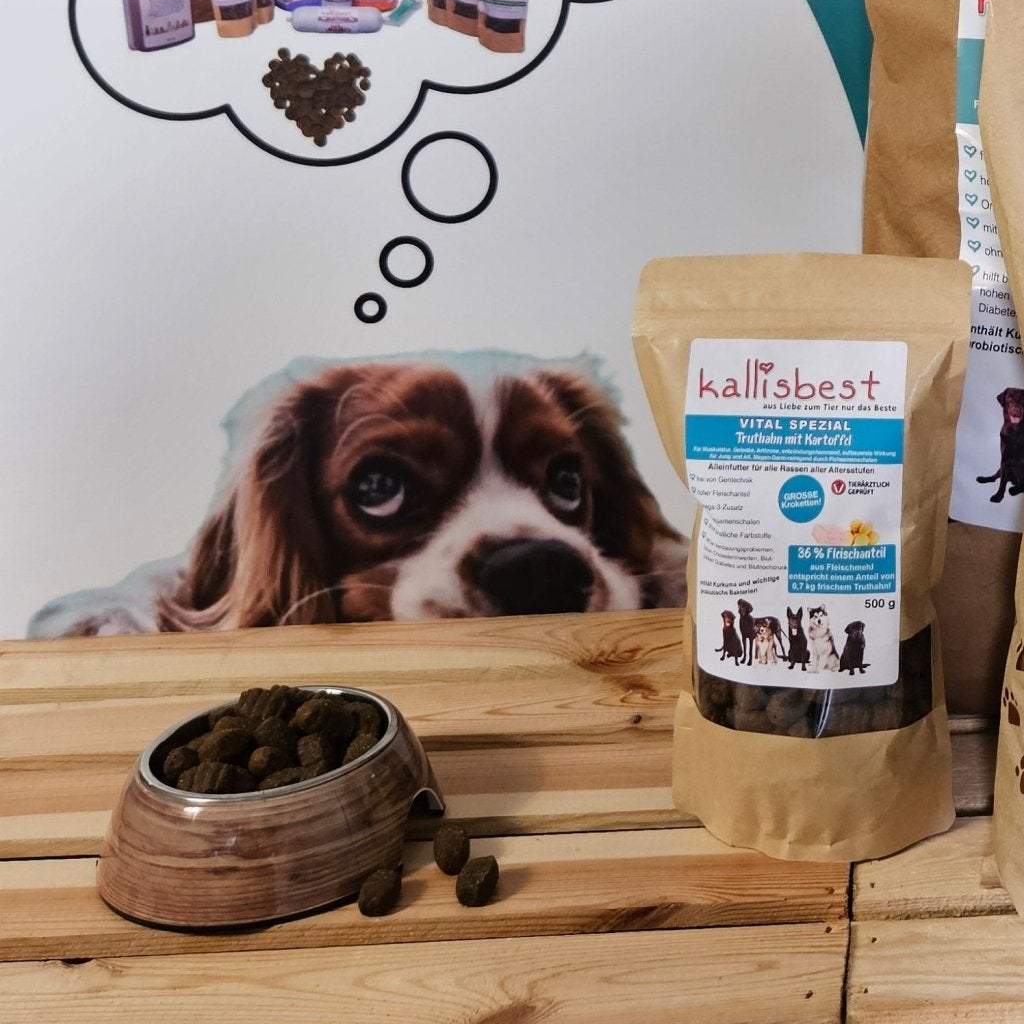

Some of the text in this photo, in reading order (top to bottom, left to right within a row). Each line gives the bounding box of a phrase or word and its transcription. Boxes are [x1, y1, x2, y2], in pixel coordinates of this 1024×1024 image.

[699, 358, 880, 400] kallisbest
[779, 402, 801, 410] Liebe
[824, 403, 839, 411] Tier
[857, 403, 872, 412] das
[874, 404, 897, 412] Beste
[739, 418, 851, 431] VITAL SPEZIAL
[735, 431, 852, 447] Truthahn mit Kartoffel
[708, 463, 749, 471] Alleinfutter
[752, 464, 763, 472] für
[764, 464, 778, 472] alle
[780, 465, 808, 473] Rassen
[828, 466, 875, 474] Altersstufen
[848, 480, 890, 488] TIERÄRZTLICH
[784, 490, 818, 500] GROSSE
[781, 498, 822, 509] Kroketten!
[798, 547, 887, 560] 36 % Fleischanteil
[753, 575, 780, 585] wichtige
[788, 573, 829, 581] entspricht
[830, 573, 854, 581] einem
[855, 573, 879, 581] Anteil
[792, 582, 891, 592] 0,7 kg frischem Truthahn!
[864, 599, 896, 610] 500 g
